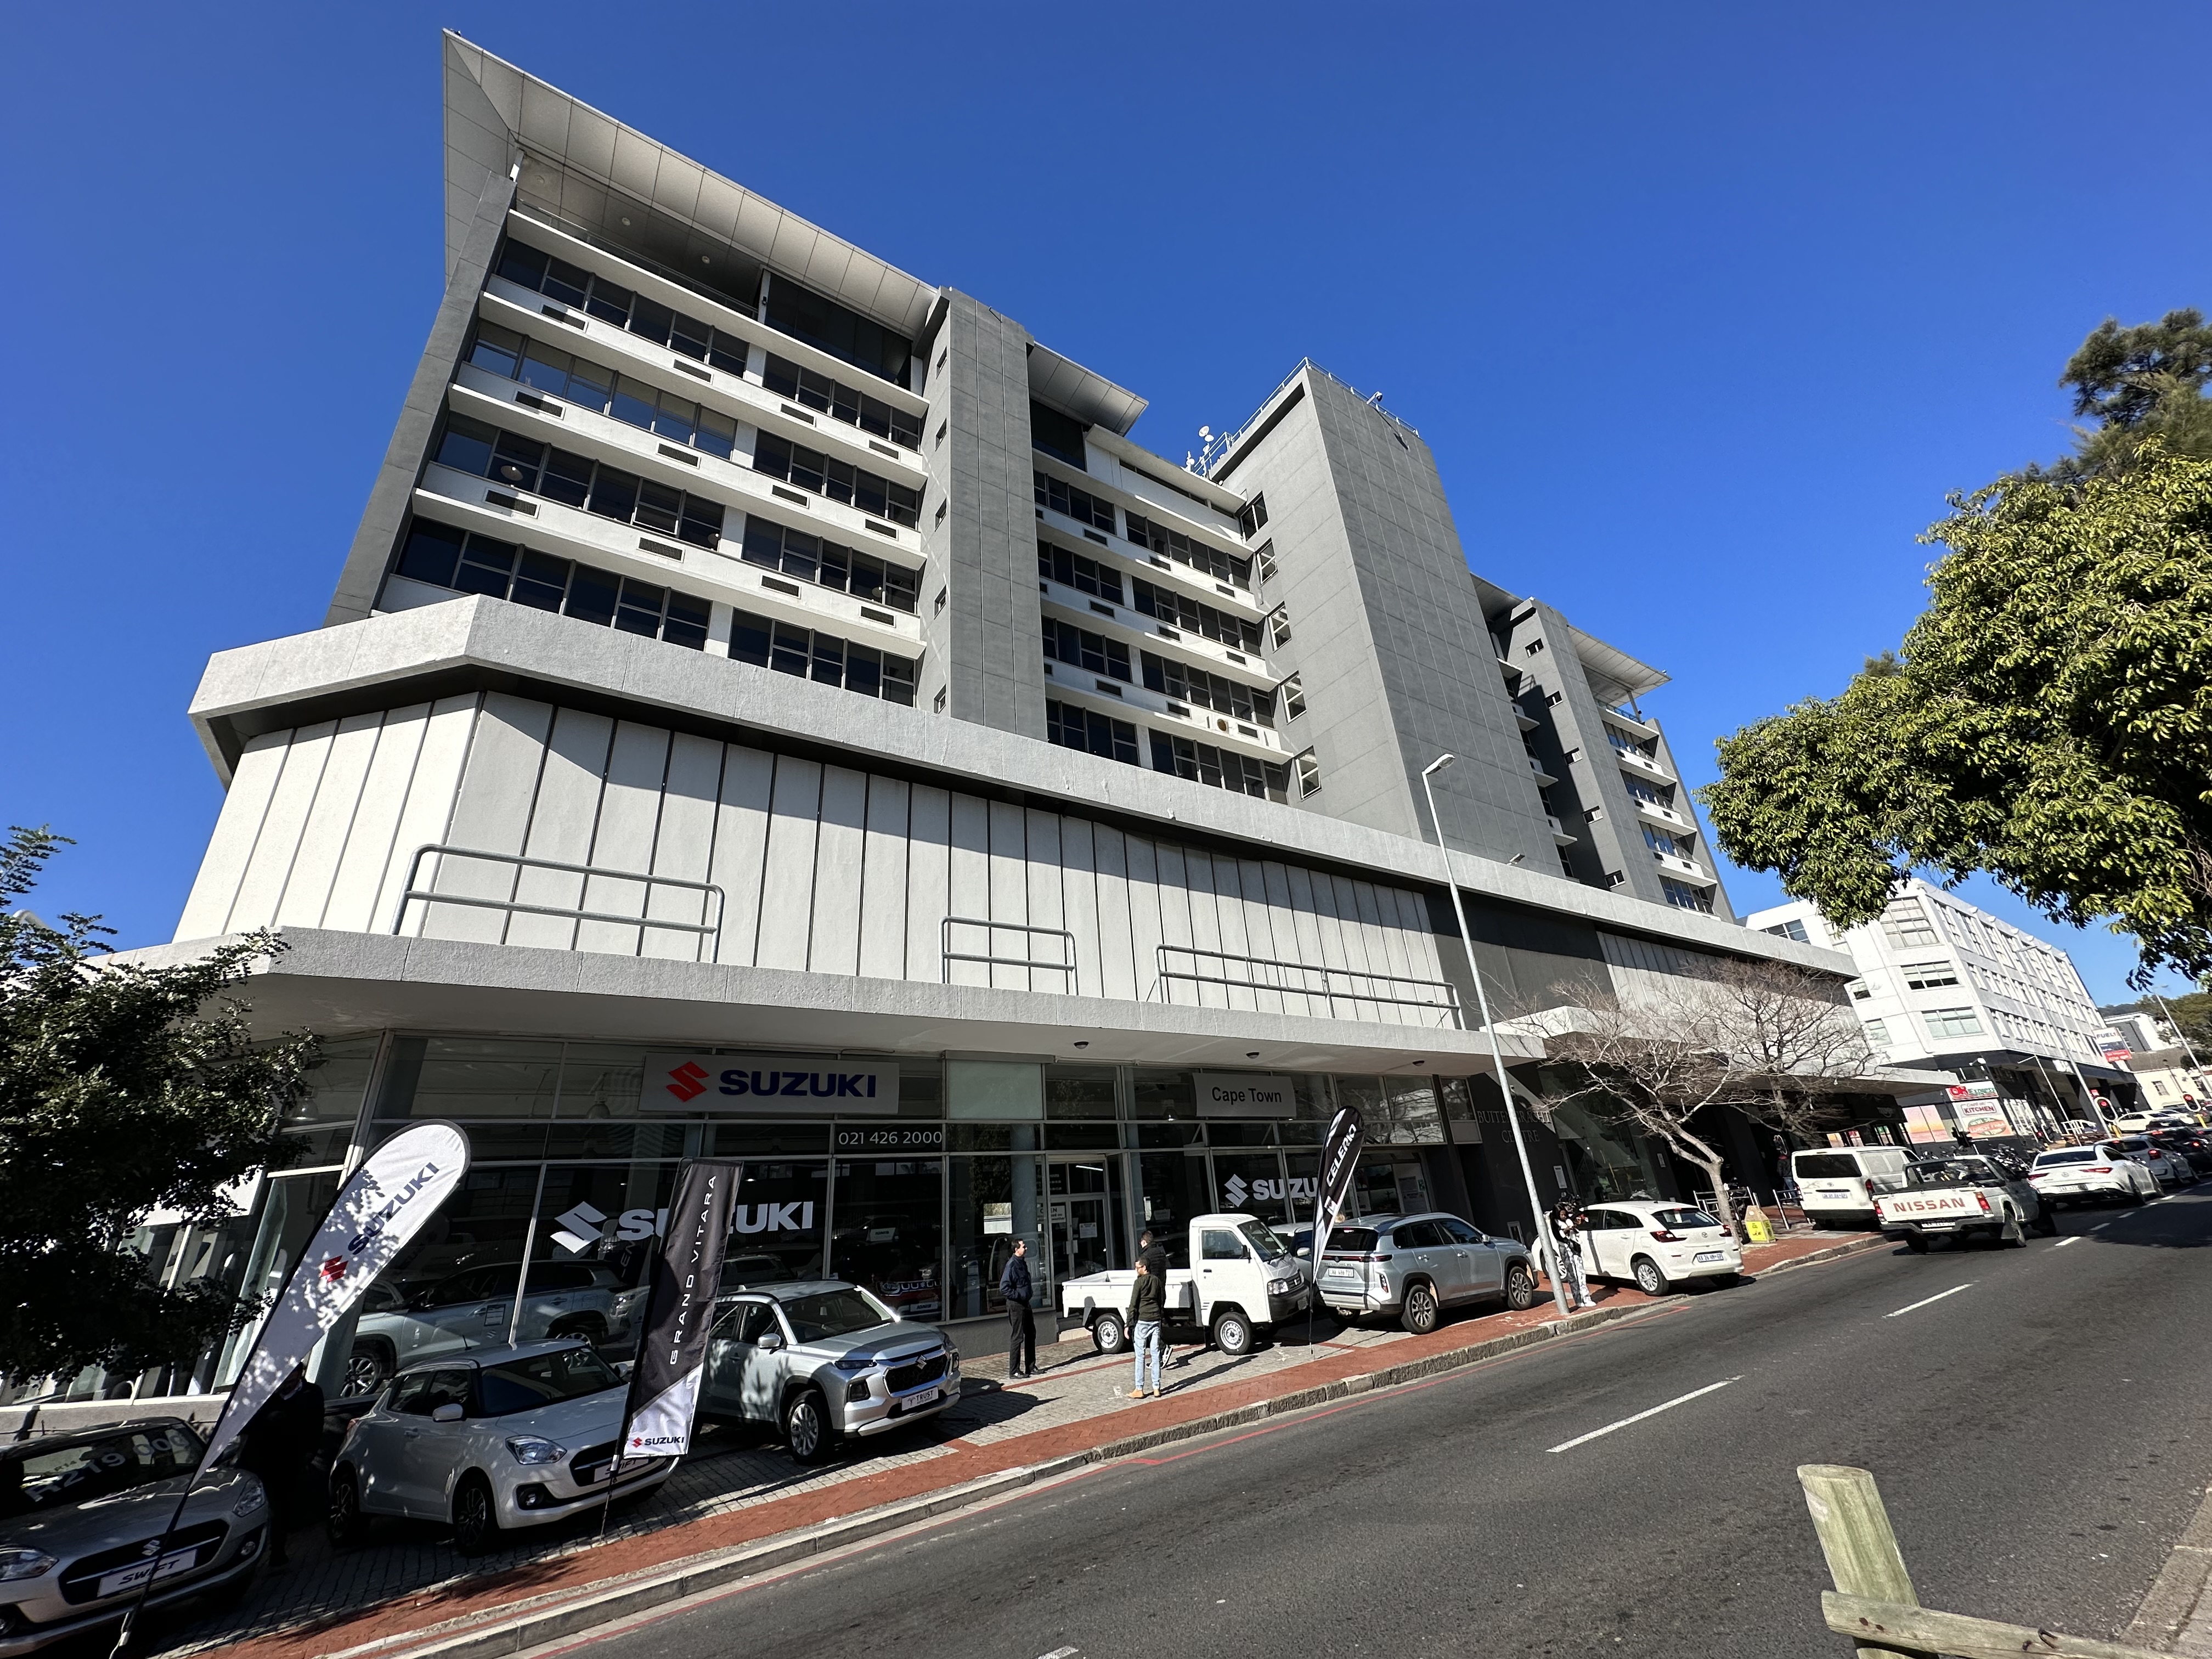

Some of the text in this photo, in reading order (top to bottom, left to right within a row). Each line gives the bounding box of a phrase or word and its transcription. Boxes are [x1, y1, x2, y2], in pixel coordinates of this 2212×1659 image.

[719, 1069, 876, 1098] SUZUKI
[1212, 1087, 1282, 1105] Cape Town
[839, 1131, 942, 1144] 021 426 2000
[1502, 1130, 1540, 1143] CETRE
[1327, 1124, 1357, 1187] CELERIO
[1252, 1177, 1318, 1200] SUZU
[347, 1162, 439, 1255] SUZUKI
[1893, 1198, 1965, 1212] NISSAN
[617, 1201, 814, 1240] SUKI
[670, 1176, 716, 1365] GRAND VITARA
[916, 1390, 933, 1401] TRUST
[645, 1436, 685, 1446] SUZUKI
[24, 1453, 126, 1503] R219
[118, 1560, 180, 1585] SWFT
